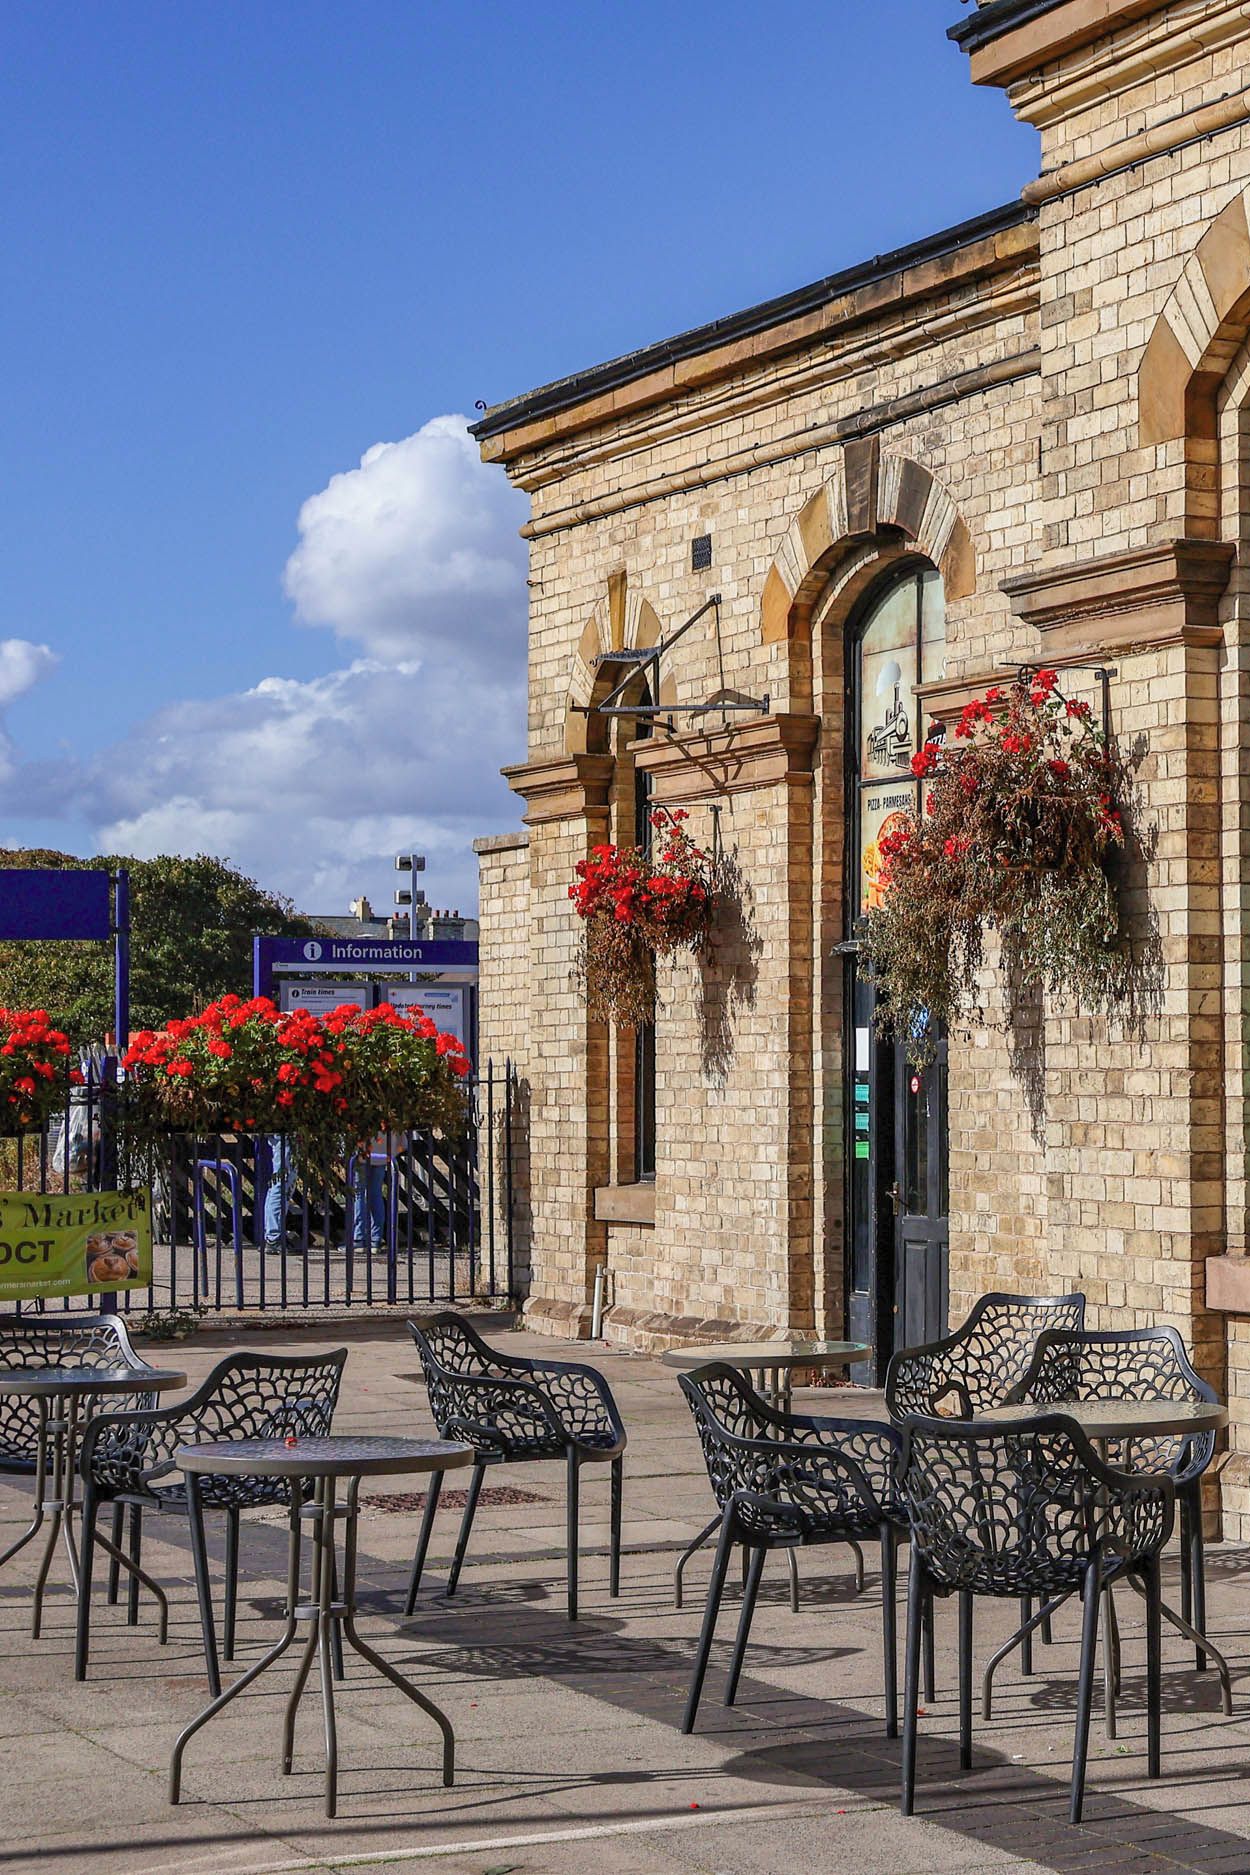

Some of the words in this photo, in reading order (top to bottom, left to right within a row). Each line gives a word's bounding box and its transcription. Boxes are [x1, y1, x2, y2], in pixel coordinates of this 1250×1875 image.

[332, 944, 423, 959] Information
[301, 988, 317, 996] Train
[318, 988, 335, 996] times
[23, 1199, 138, 1228] Market
